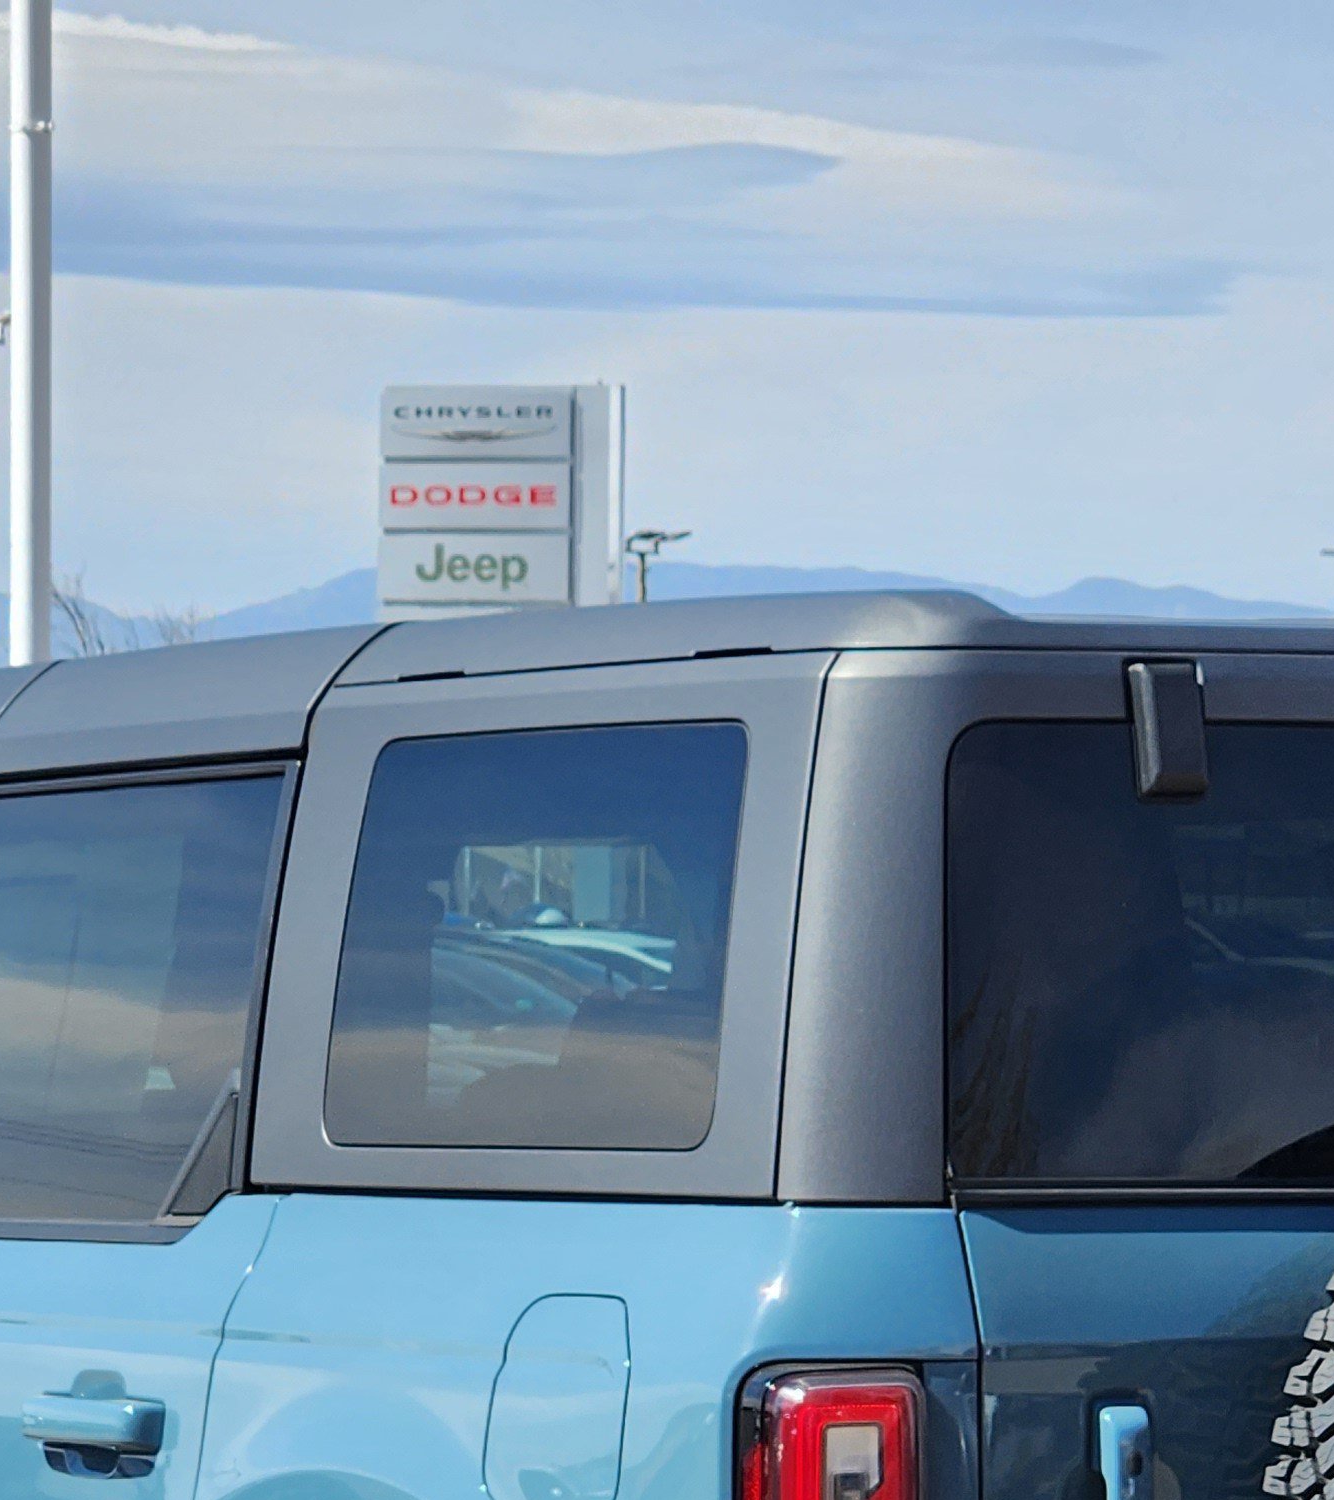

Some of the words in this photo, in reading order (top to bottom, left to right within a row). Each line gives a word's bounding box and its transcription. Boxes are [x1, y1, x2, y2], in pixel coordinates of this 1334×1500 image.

[393, 405, 554, 419] CHRYSLER
[390, 485, 557, 506] DODGE
[415, 542, 529, 591] Jeep
